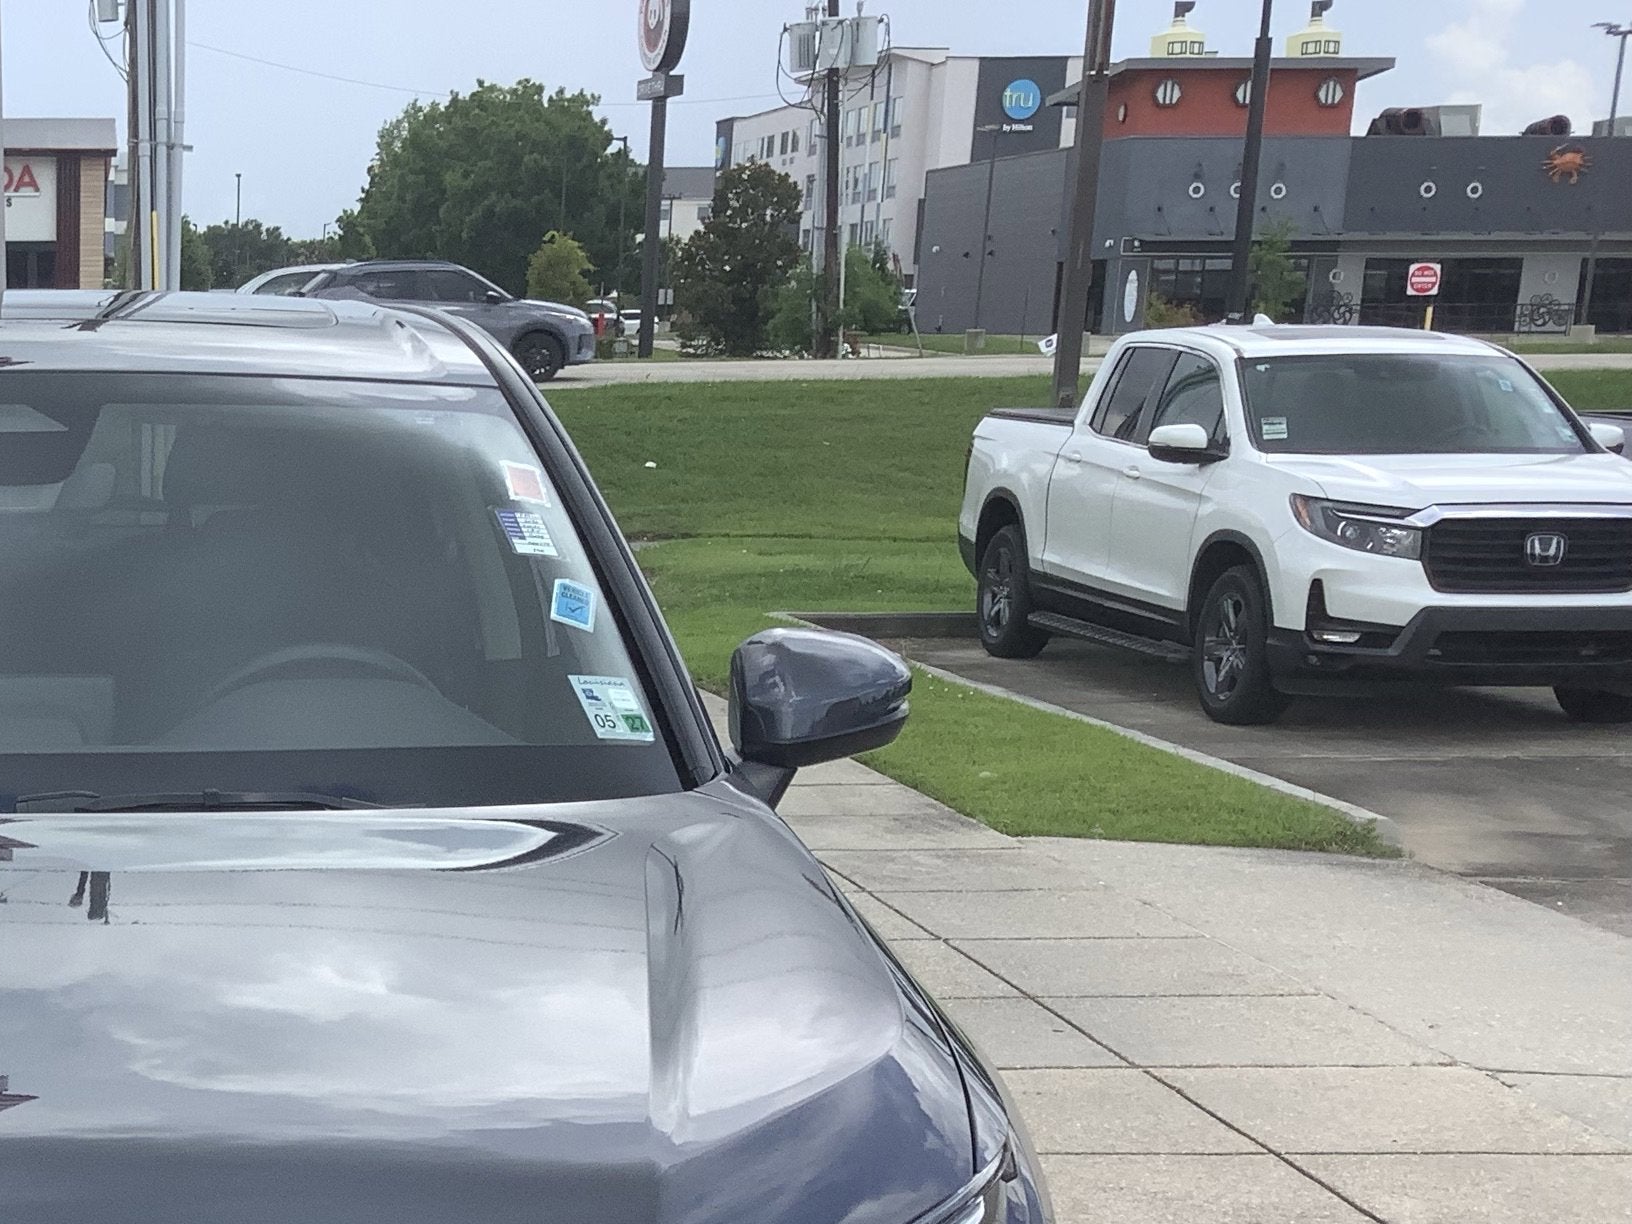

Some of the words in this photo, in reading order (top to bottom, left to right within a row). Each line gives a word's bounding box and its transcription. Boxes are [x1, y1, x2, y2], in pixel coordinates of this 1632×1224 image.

[1004, 88, 1033, 108] tru
[1002, 124, 1011, 132] by
[594, 713, 617, 729] 05
[626, 716, 646, 731] 27
